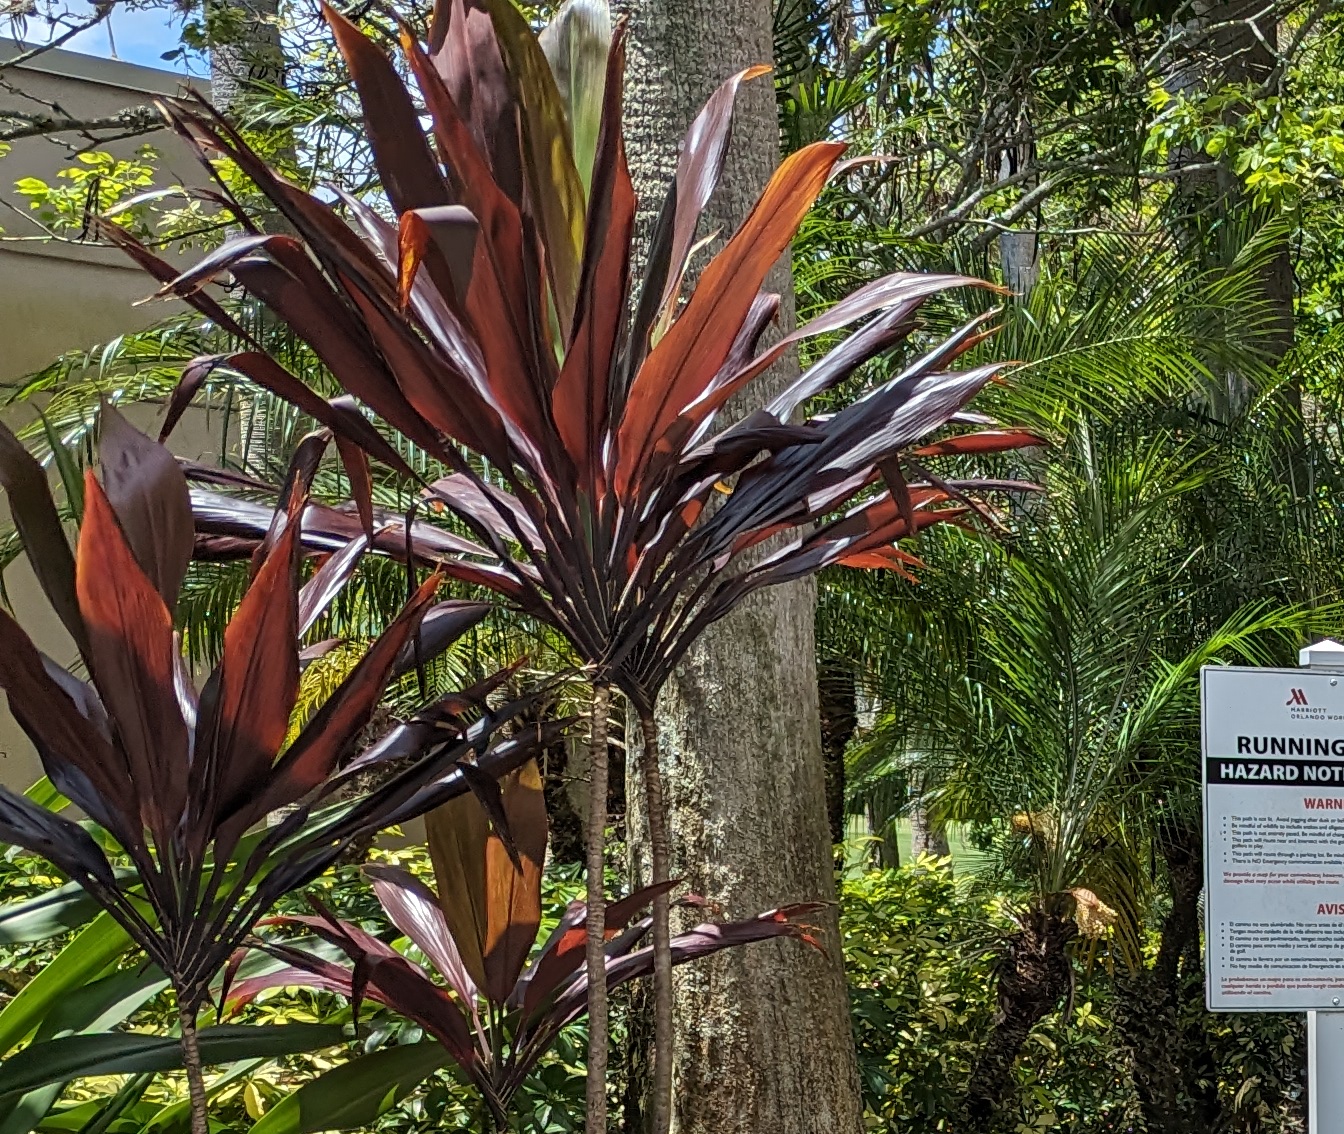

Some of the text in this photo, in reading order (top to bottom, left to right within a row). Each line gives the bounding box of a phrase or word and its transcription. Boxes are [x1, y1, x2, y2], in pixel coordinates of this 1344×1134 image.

[1290, 706, 1327, 714] MARRIOTT
[1290, 713, 1326, 721] ORLANDO
[1220, 763, 1300, 781] HAZARD
